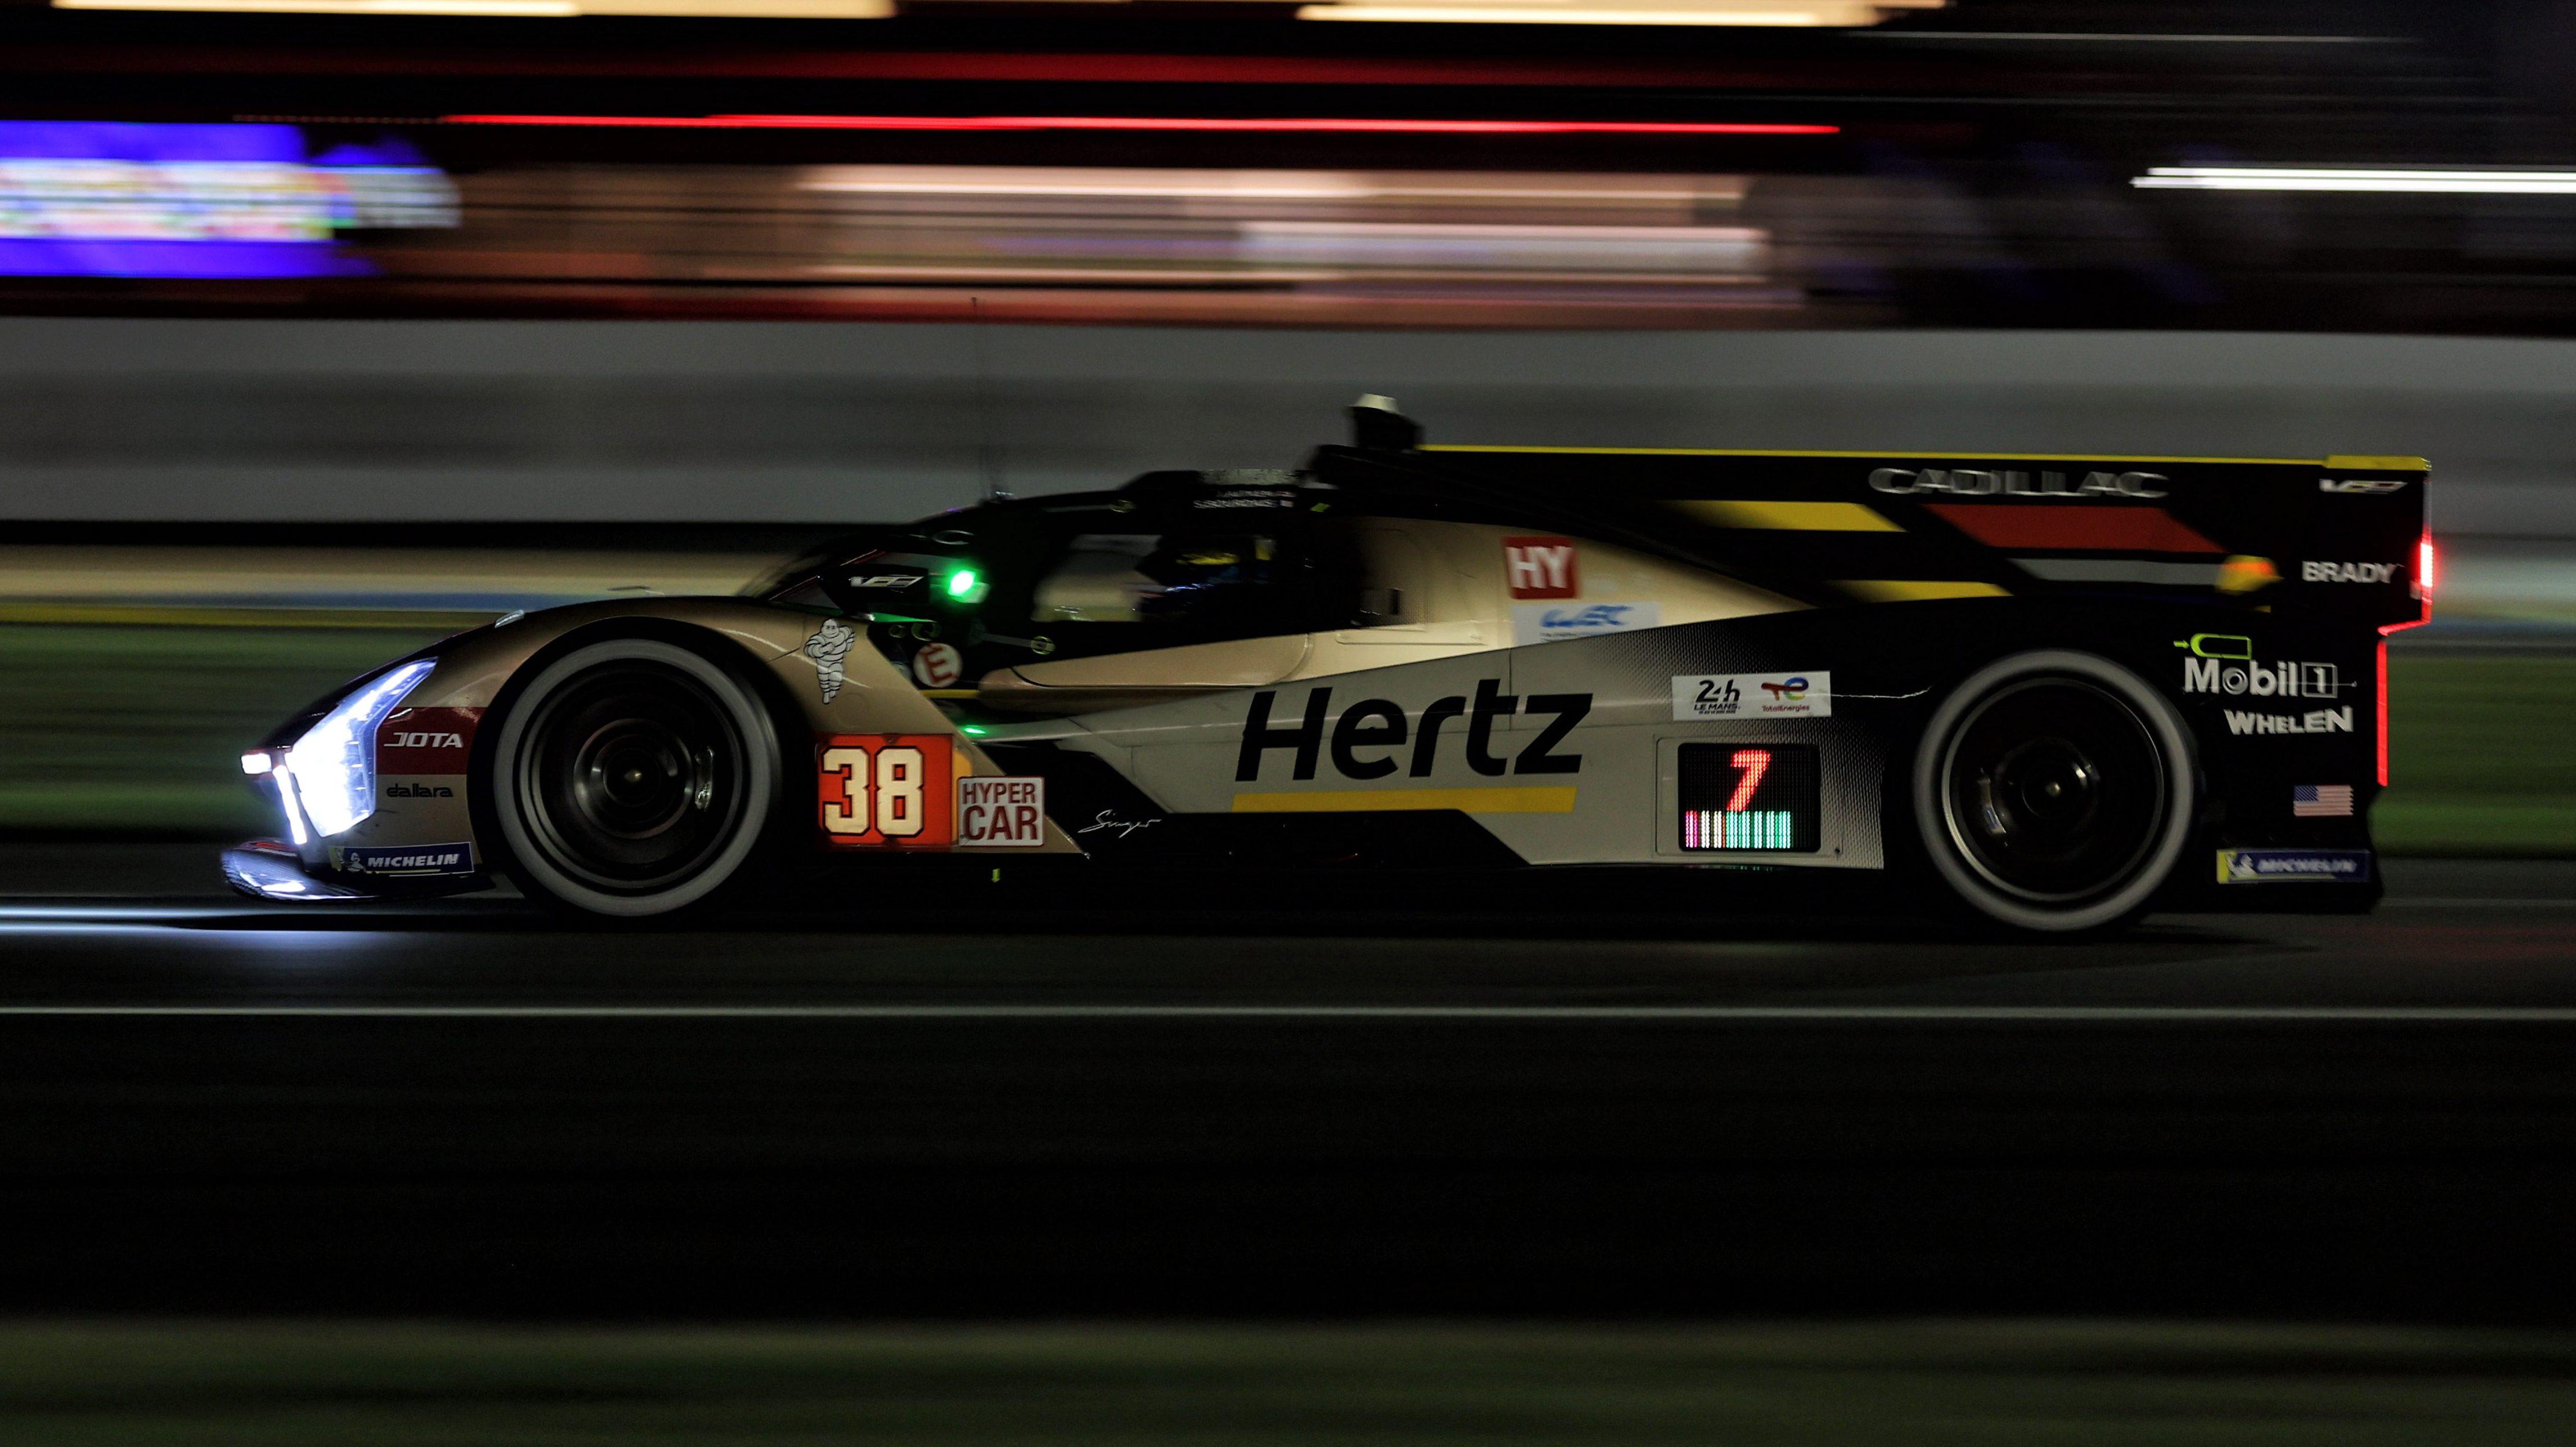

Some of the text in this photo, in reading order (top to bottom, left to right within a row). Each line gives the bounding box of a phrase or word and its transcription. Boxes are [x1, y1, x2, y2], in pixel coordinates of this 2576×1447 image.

[1868, 467, 2171, 499] CADILLAC
[1507, 545, 1574, 589] HY
[2302, 560, 2399, 583] BRADY
[921, 644, 956, 684] E
[2183, 656, 2299, 697] Mobil
[1696, 679, 1740, 702] 24h
[1235, 679, 1593, 779] Hertz
[2223, 705, 2354, 735] WHELEN
[383, 732, 464, 748] JOTA
[387, 784, 453, 797] dallara
[821, 745, 925, 837] 38
[963, 783, 1036, 804] HYPER
[1726, 749, 1771, 813] 7
[963, 806, 1038, 840] CAR
[367, 853, 460, 868] MICHELIN
